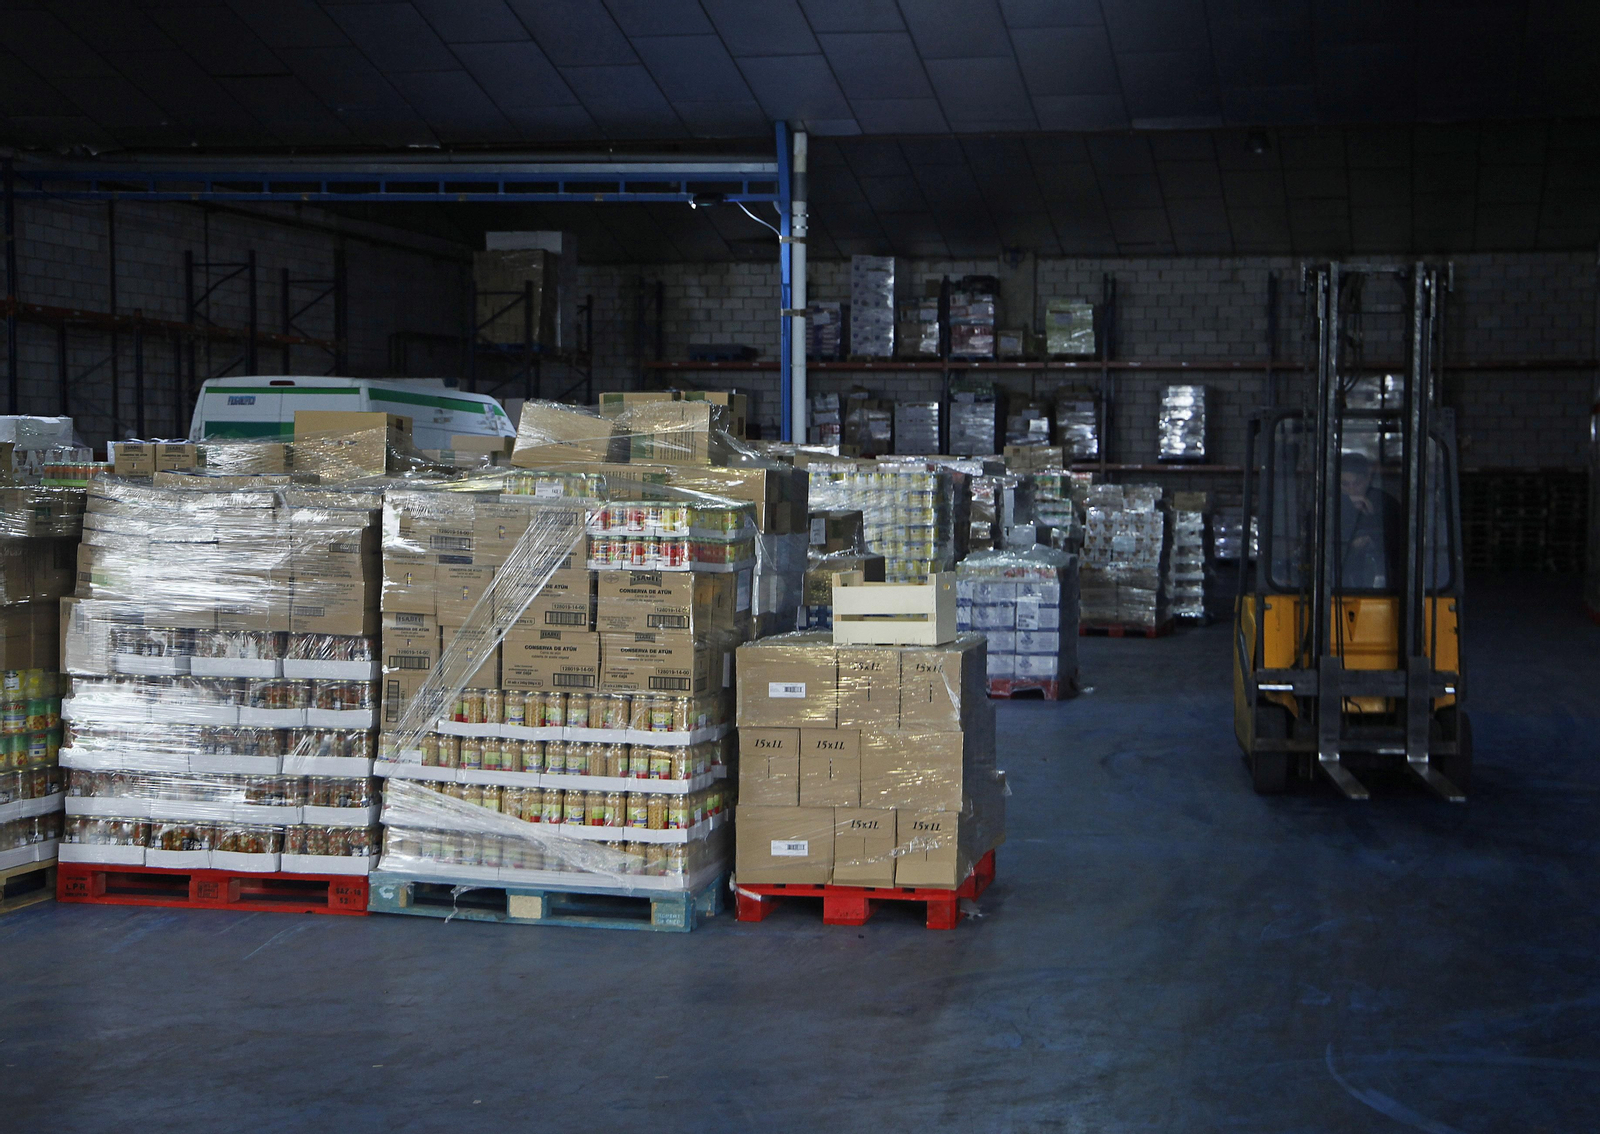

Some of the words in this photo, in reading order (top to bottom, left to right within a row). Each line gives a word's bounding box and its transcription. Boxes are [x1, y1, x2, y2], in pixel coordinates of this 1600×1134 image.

[755, 739, 783, 748] 15x1L
[817, 740, 844, 750] 15x1L
[851, 820, 879, 829] 15x1L
[913, 821, 941, 831] 15x1L
